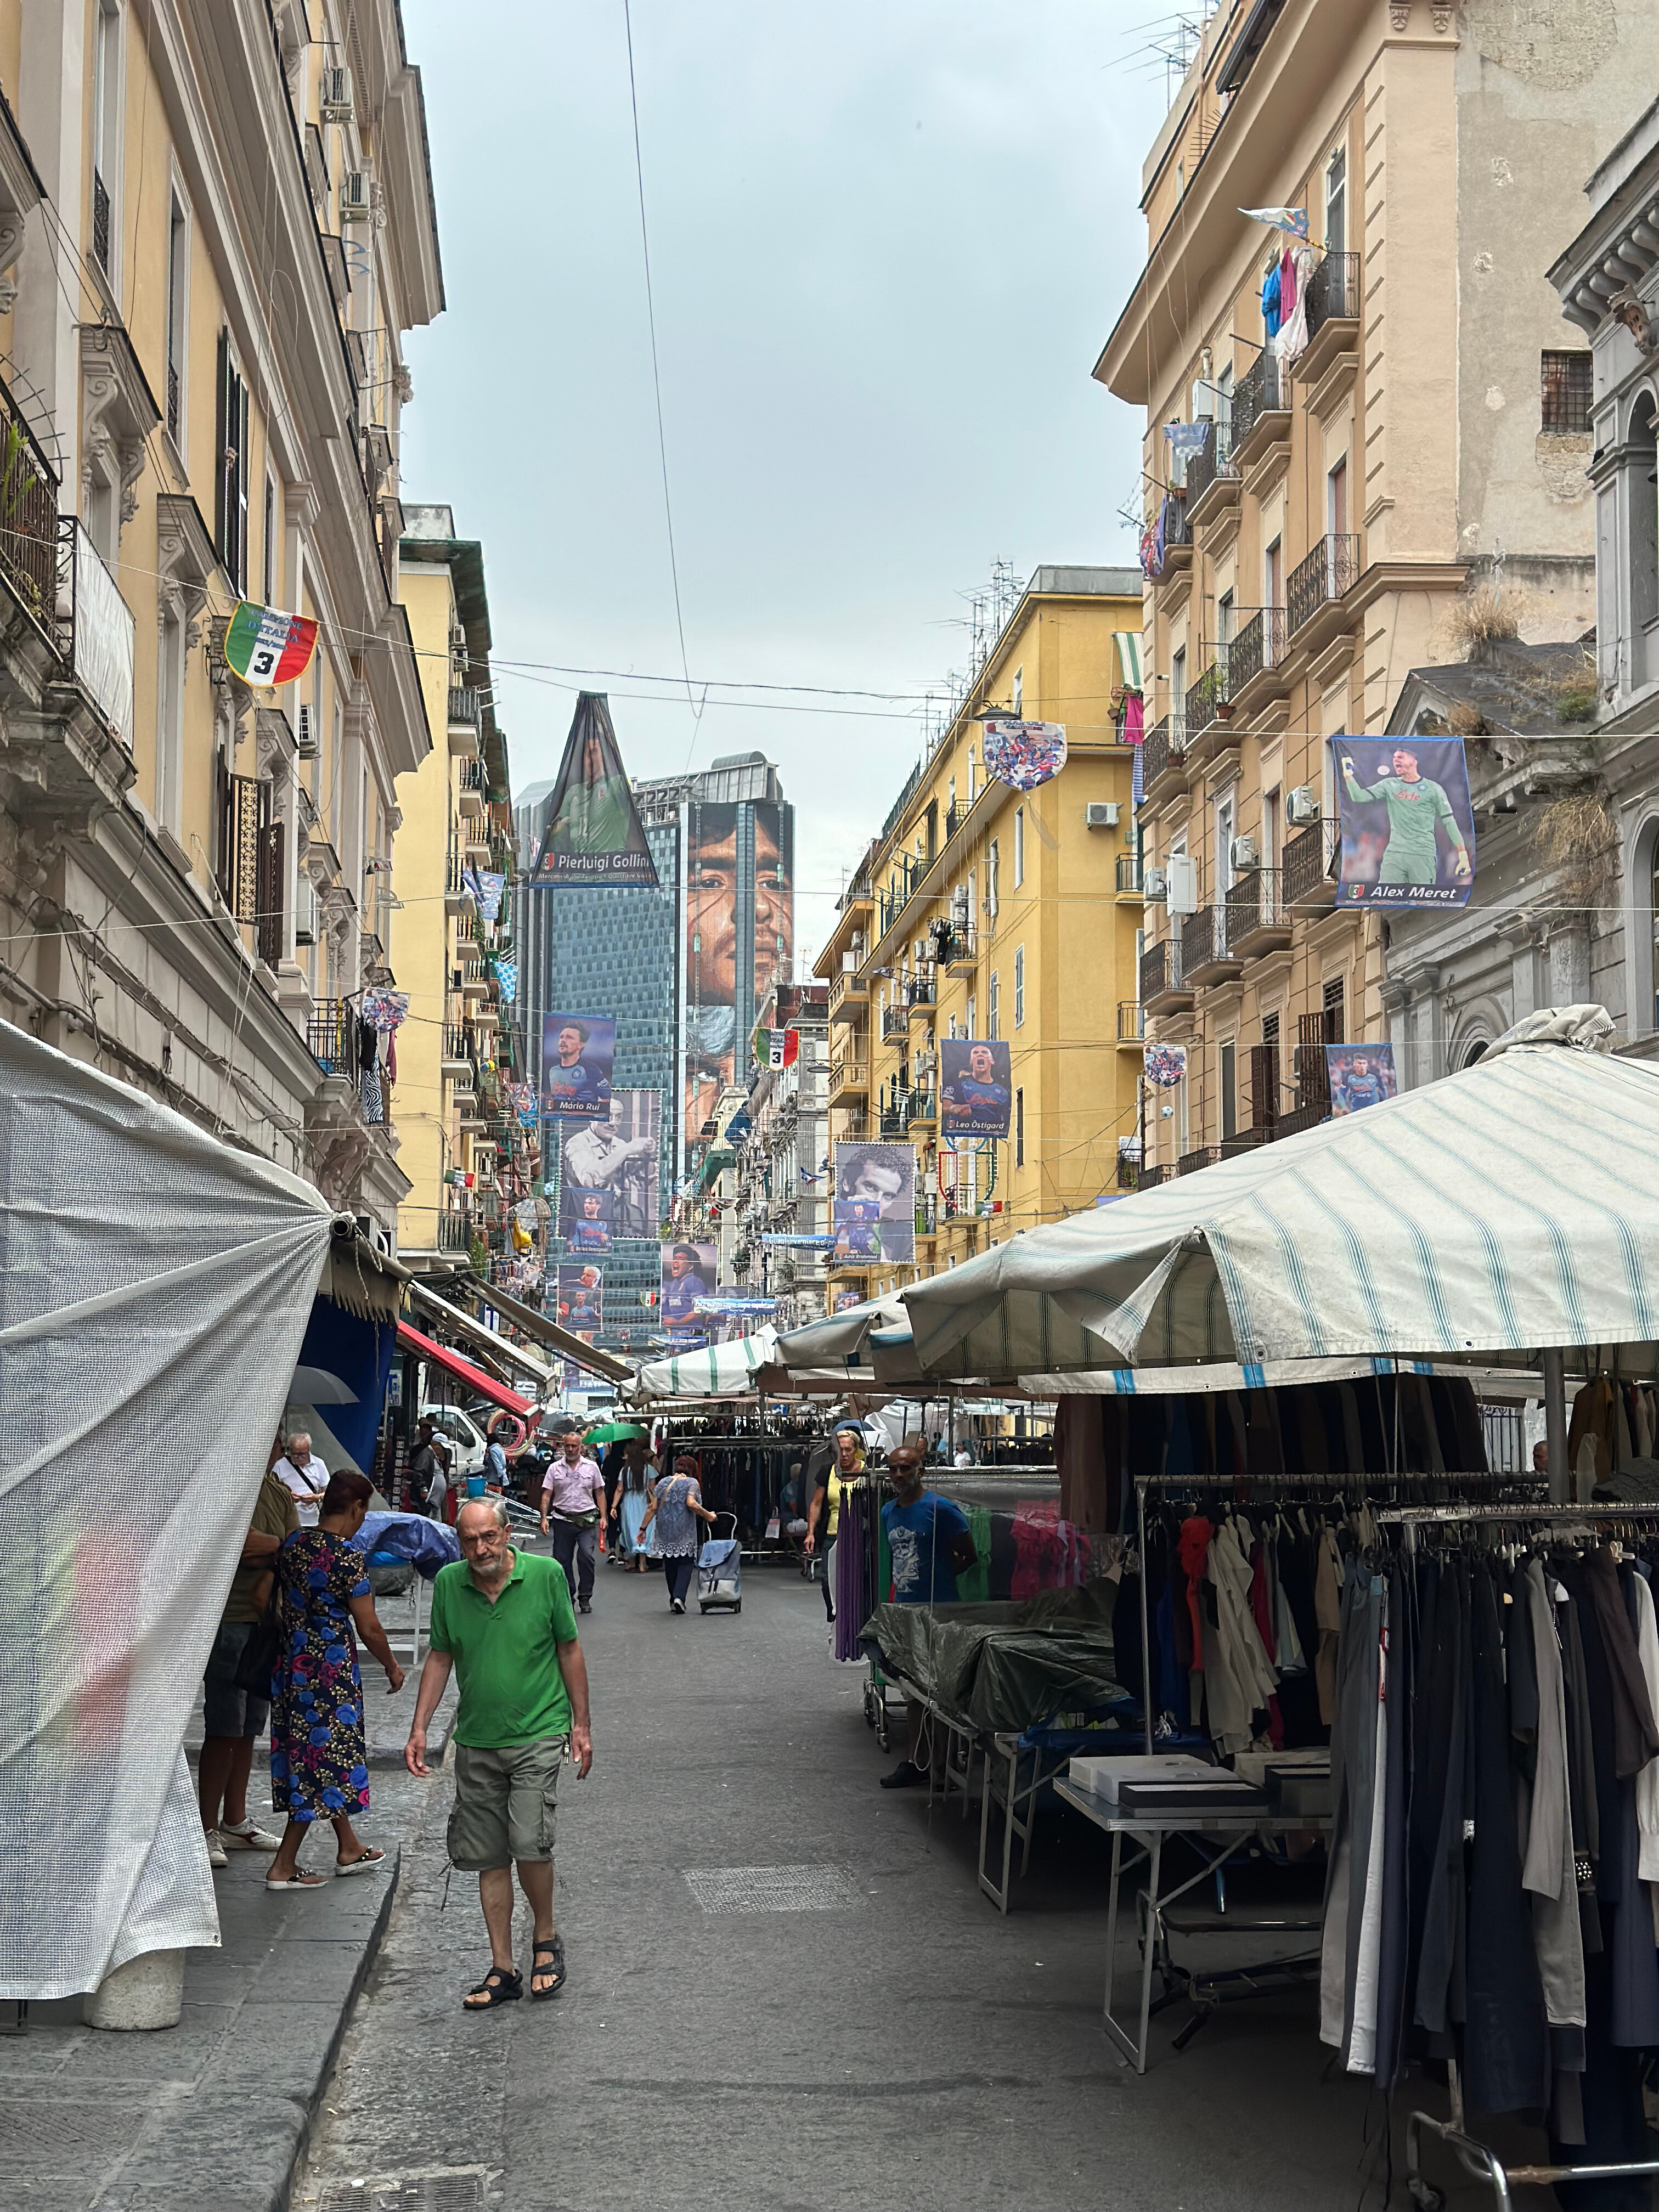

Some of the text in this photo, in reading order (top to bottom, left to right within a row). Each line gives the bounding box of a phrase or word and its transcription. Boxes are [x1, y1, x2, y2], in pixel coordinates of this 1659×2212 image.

[248, 621, 298, 643] D'ITALIA
[254, 651, 274, 675] 3
[558, 855, 608, 872] Pierluigi
[1371, 887, 1457, 899] Alex Meret
[772, 1051, 781, 1064] 3
[560, 1102, 584, 1110] Mário
